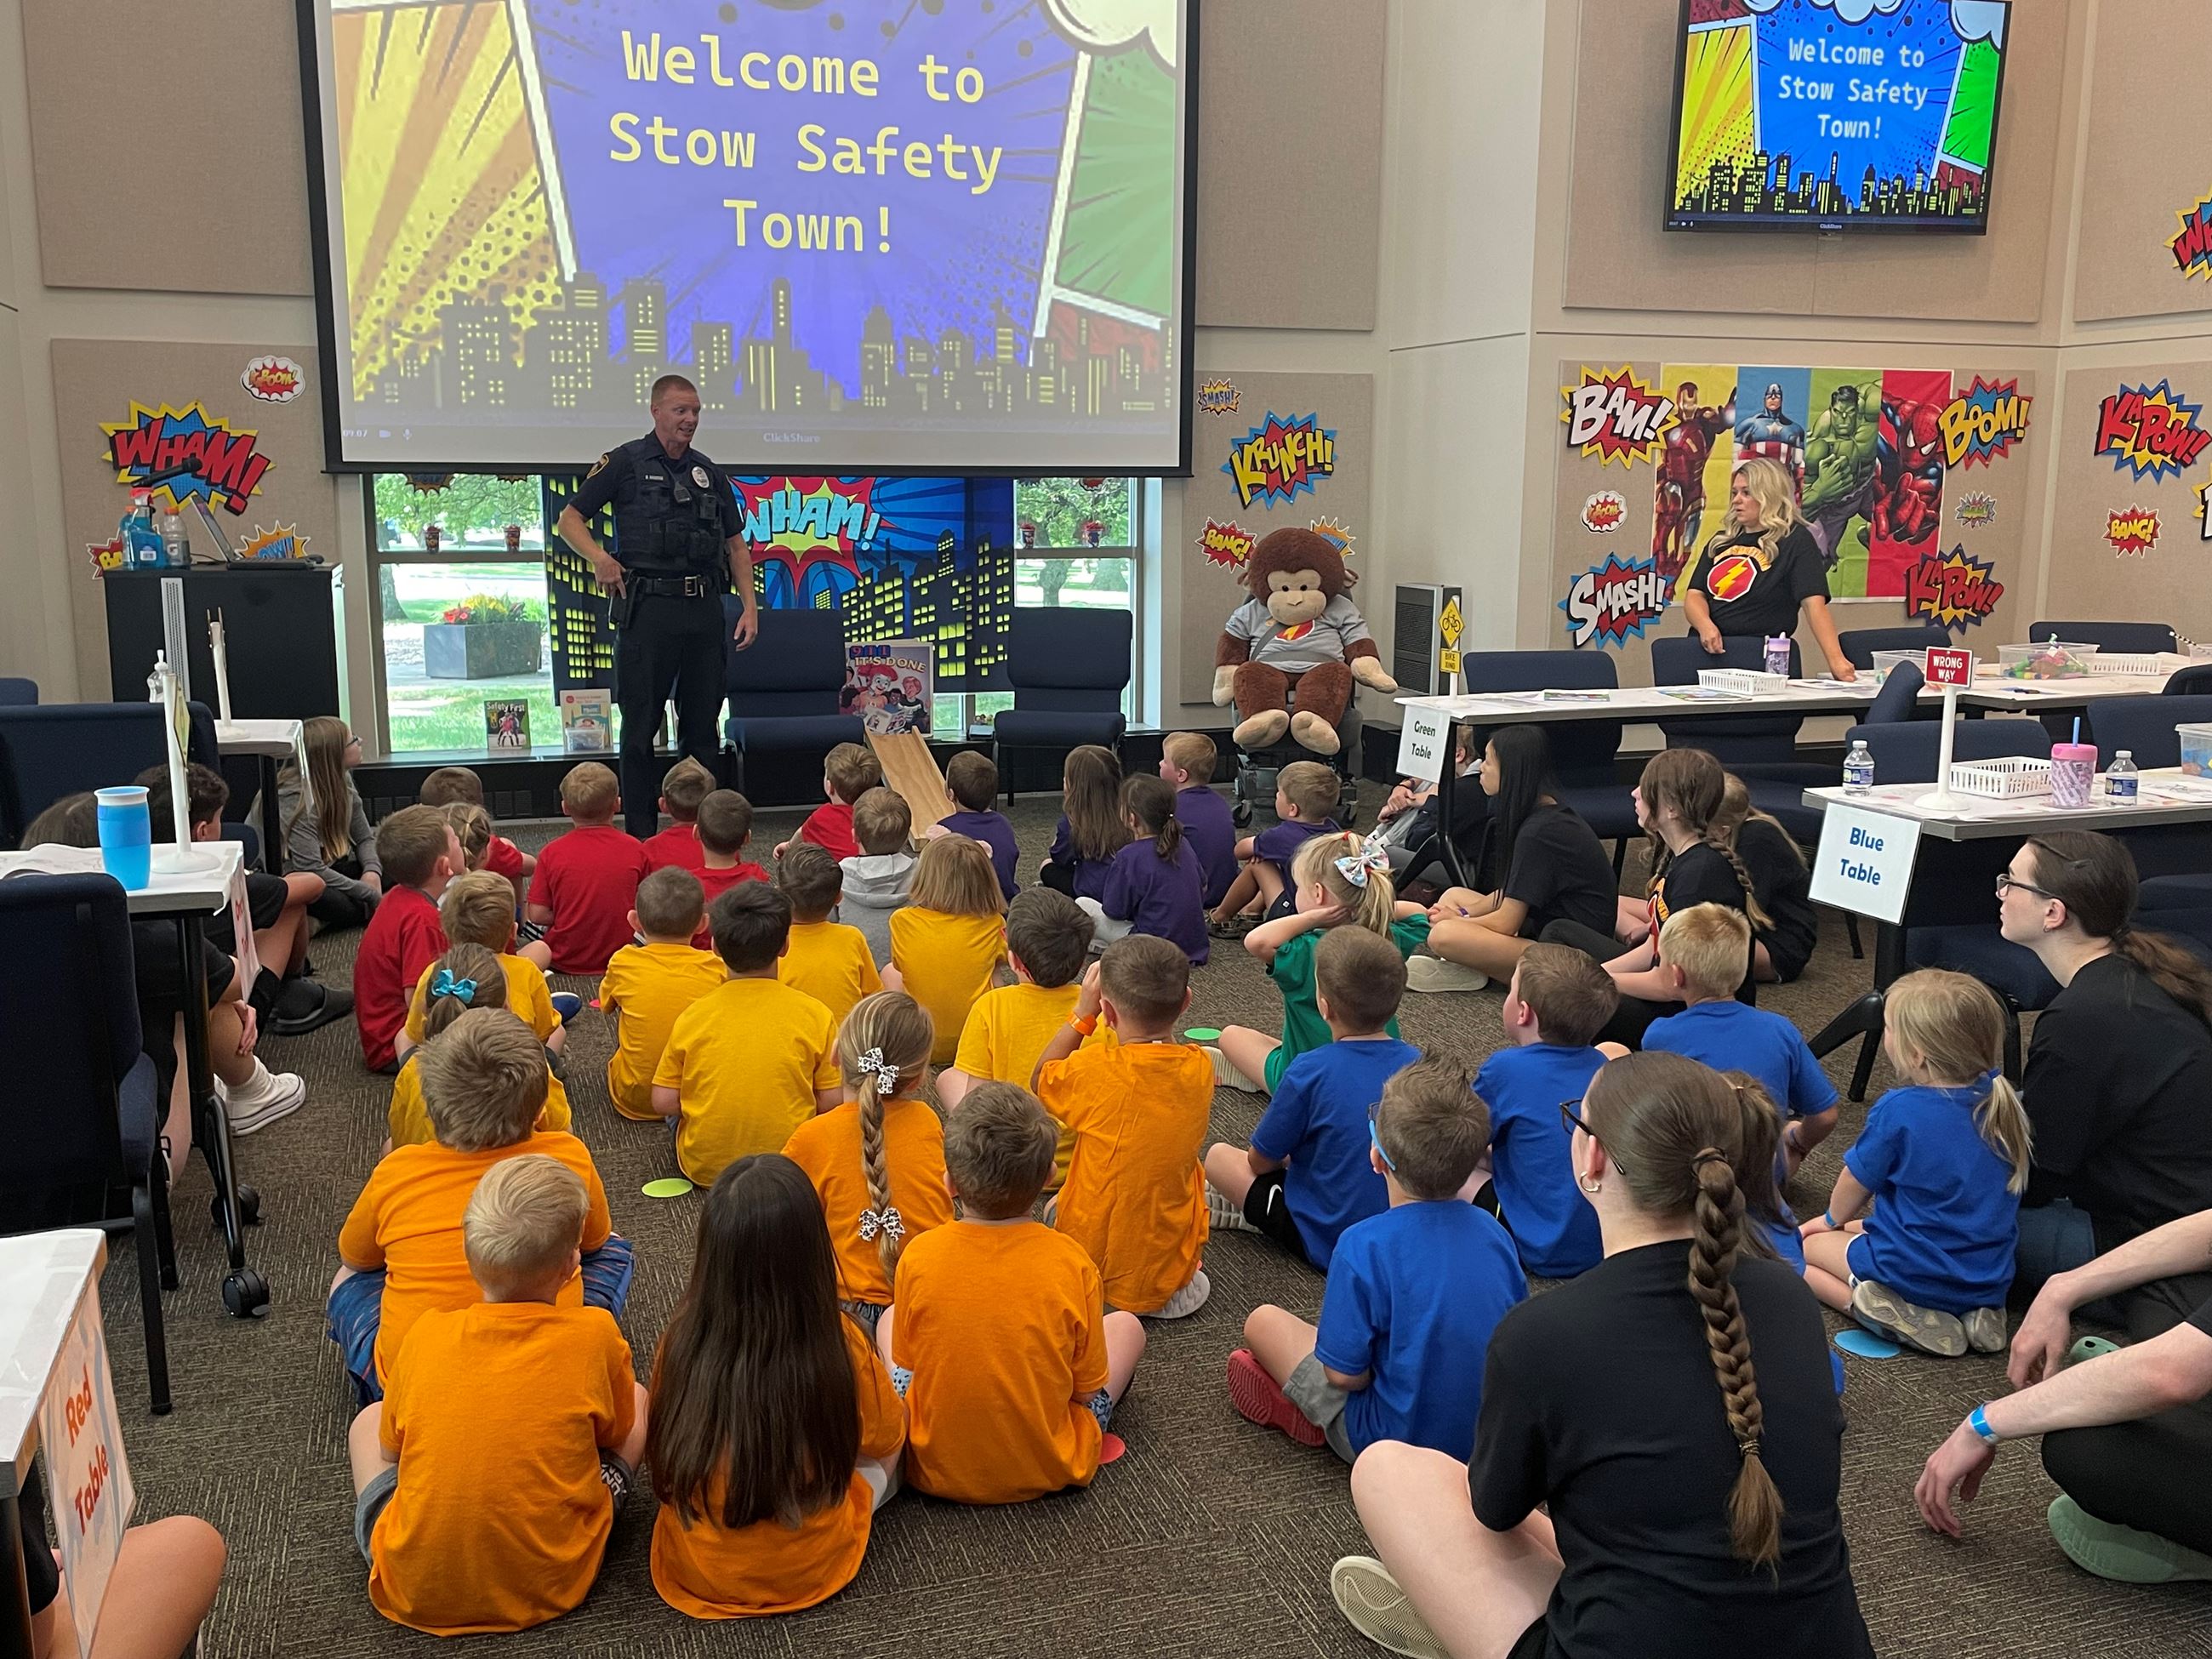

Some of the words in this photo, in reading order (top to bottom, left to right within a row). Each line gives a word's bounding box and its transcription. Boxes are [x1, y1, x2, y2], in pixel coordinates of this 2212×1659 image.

[622, 31, 880, 98] Welcome
[920, 54, 985, 104] to
[1789, 38, 1884, 67] Welcome
[1899, 43, 1924, 68] to
[1778, 75, 1833, 101] Stow
[1847, 77, 1928, 111] Safety
[1817, 114, 1882, 140] Town!
[609, 112, 755, 169] Stow
[796, 123, 1002, 195] Safety
[722, 198, 892, 254] Town!
[1201, 390, 1234, 406] SMASH!
[1567, 383, 1675, 447] BAM!
[1938, 395, 2031, 470] BOOM!
[111, 418, 271, 516] WHAM!
[1230, 429, 1334, 510] KRUNCH!
[1205, 529, 1251, 562] BANG!
[2109, 518, 2155, 544] BANG!
[1570, 572, 1666, 650] SMASH!
[855, 657, 882, 667] IT'S
[887, 658, 926, 673] DONE
[1933, 655, 1964, 670] WRONG
[1937, 667, 1957, 681] WAY
[1414, 720, 1436, 738] Green
[1411, 743, 1432, 760] Table
[1849, 826, 1884, 852] Blue
[1839, 858, 1882, 886] Table
[66, 1363, 93, 1448] Red
[74, 1443, 110, 1536] Table
